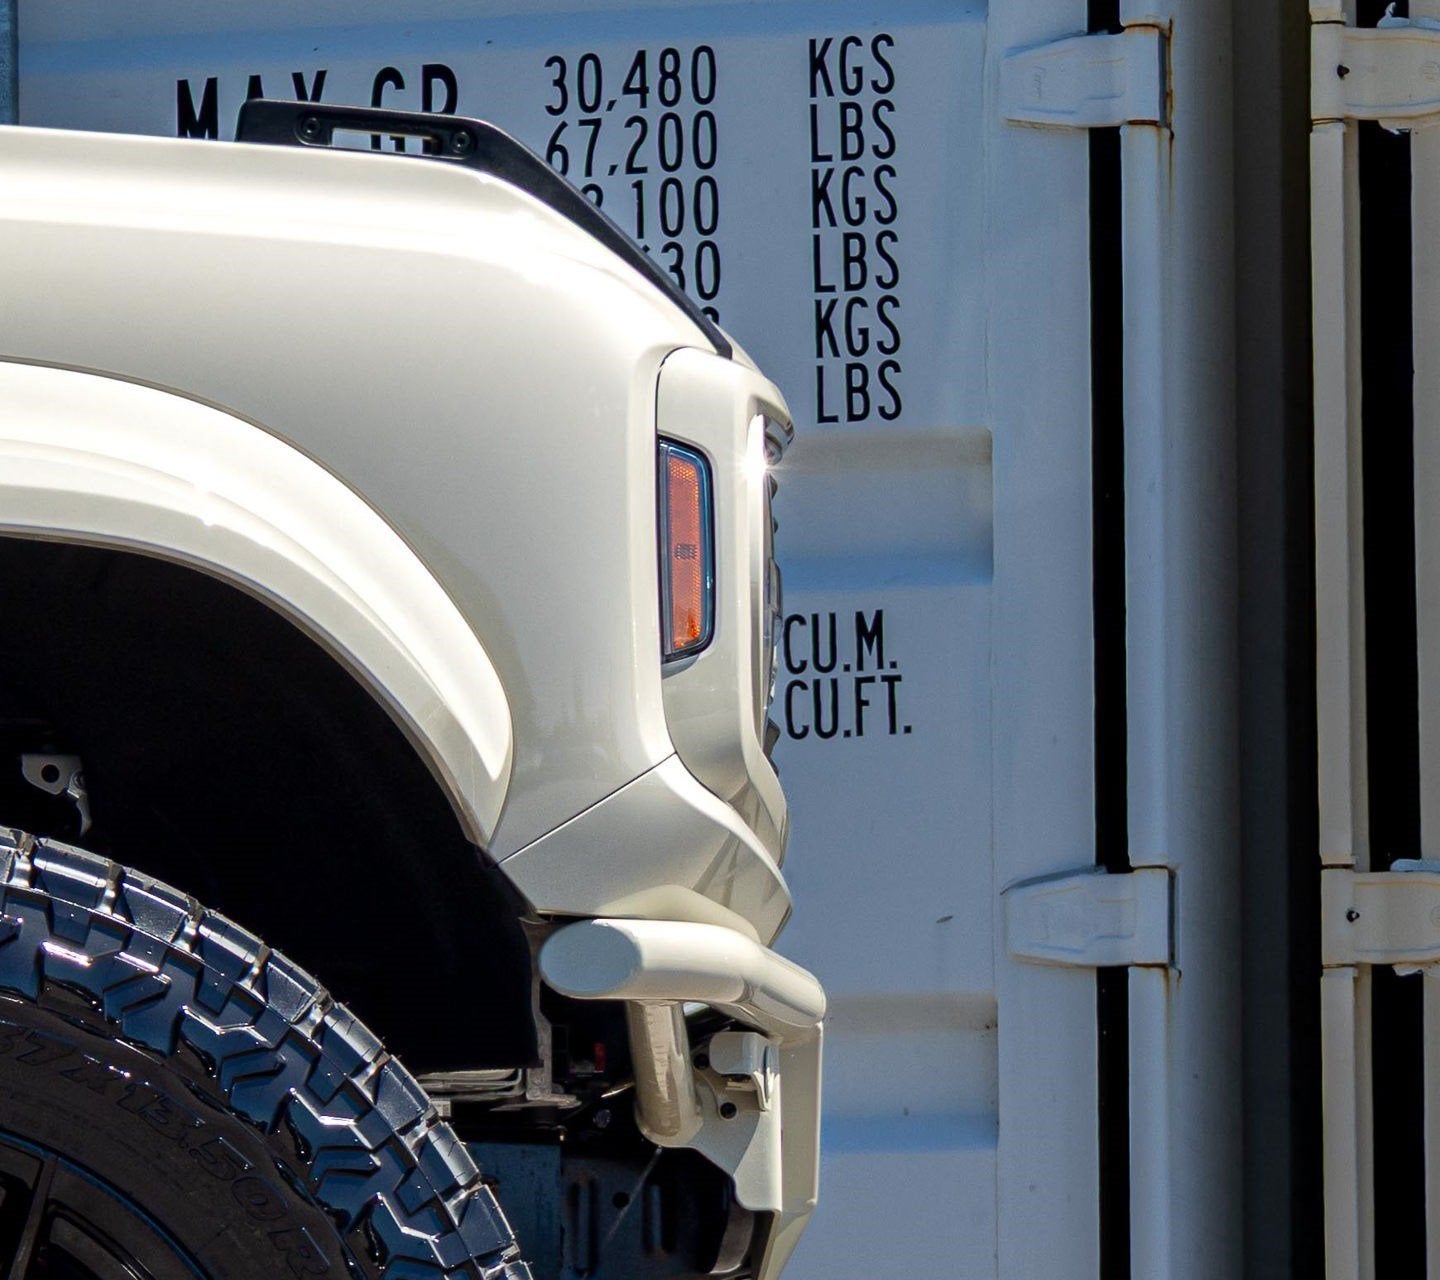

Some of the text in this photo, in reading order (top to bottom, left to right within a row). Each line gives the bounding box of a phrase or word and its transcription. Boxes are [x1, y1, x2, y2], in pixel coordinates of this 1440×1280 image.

[544, 33, 895, 113] 30,480 KGS
[545, 99, 896, 177] 67,200 LBS
[811, 164, 898, 229] KGS
[812, 230, 900, 293] LBS
[814, 295, 901, 358] KGS
[816, 359, 902, 424] LBS
[783, 608, 898, 675] CU.M.
[784, 674, 912, 740] CU.FT.
